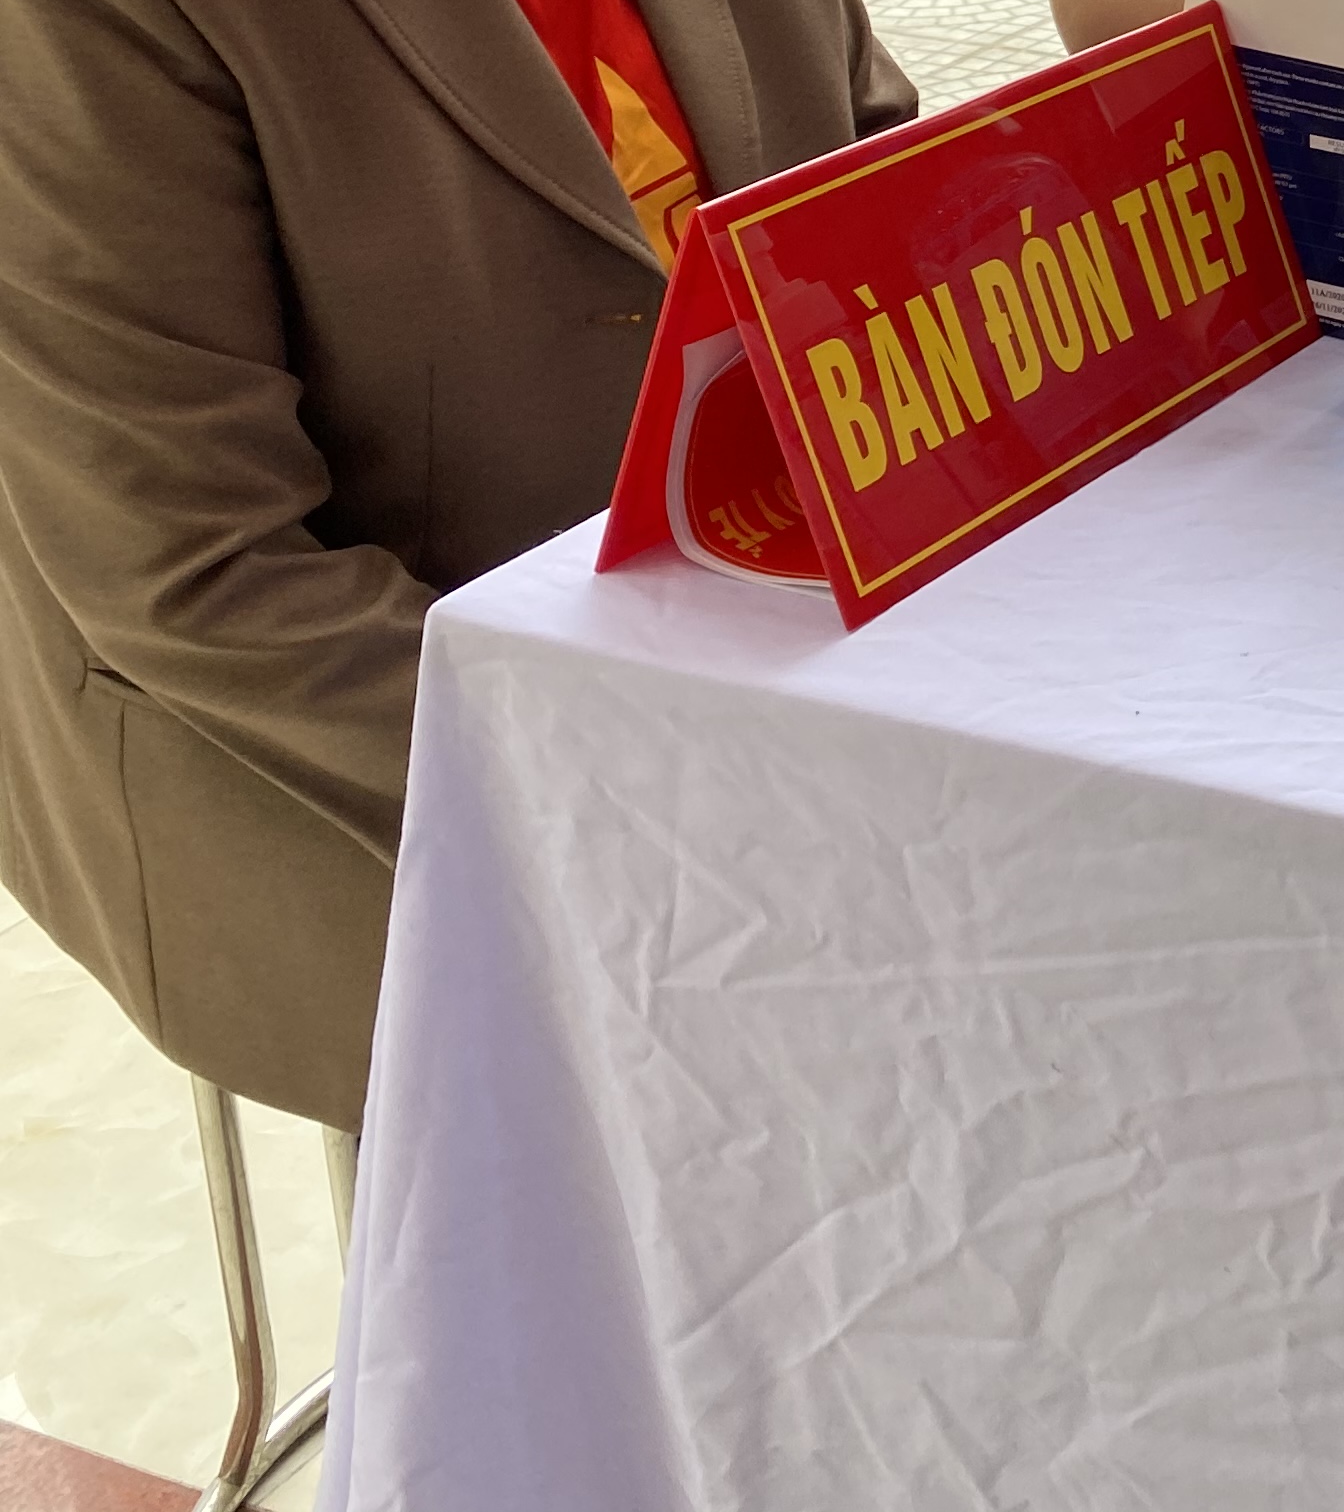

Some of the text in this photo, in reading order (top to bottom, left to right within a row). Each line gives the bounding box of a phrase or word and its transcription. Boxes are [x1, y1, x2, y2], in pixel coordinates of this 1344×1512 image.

[1257, 124, 1285, 135] ACTORS
[805, 118, 1249, 493] BÀN ĐÓN TIẾP
[707, 499, 772, 560] TẾ
